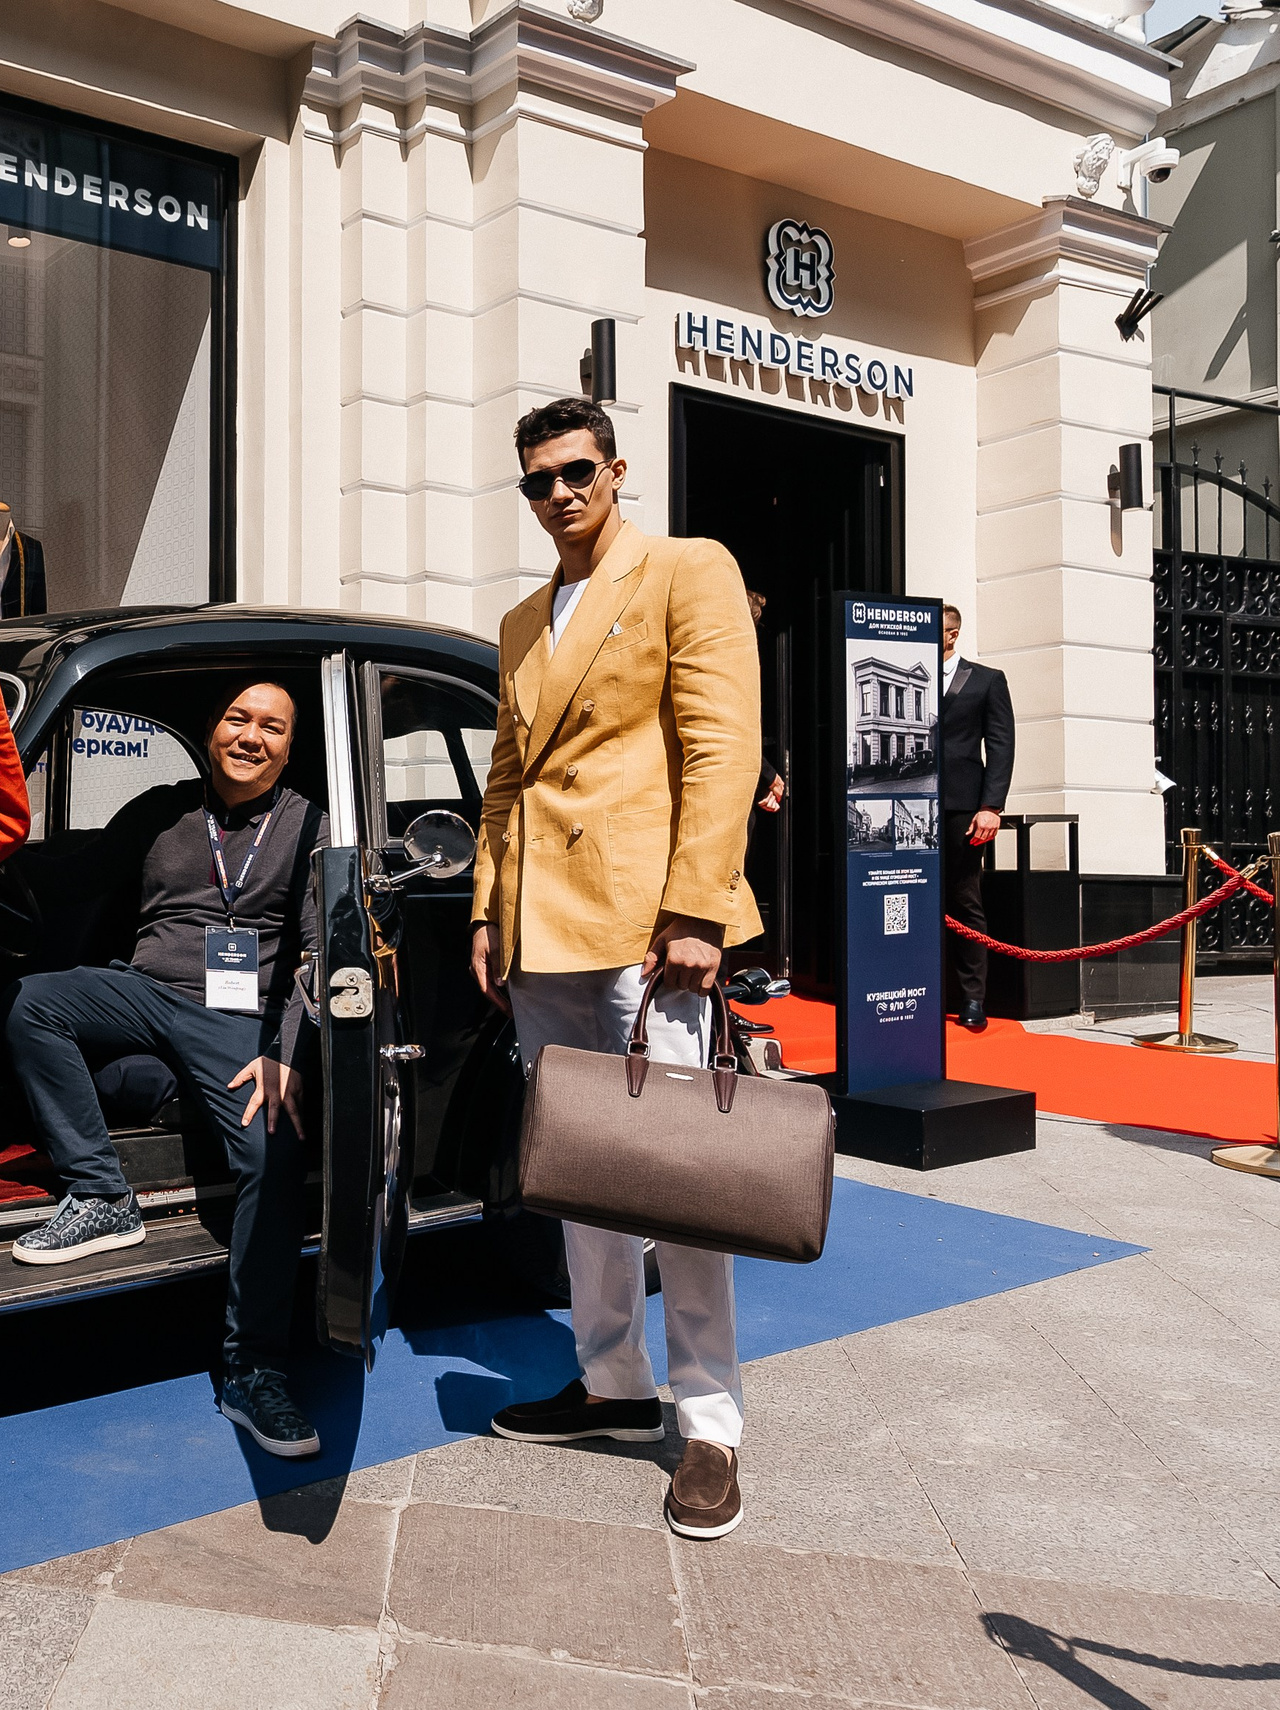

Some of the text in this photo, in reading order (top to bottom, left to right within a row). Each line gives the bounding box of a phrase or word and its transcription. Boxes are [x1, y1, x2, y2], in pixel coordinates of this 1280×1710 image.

[680, 311, 915, 400] HENDERSON
[867, 608, 932, 624] HENDERSON
[72, 737, 148, 758] еркам!
[866, 987, 927, 1002] КУЗНЕЦКИЙ МОСТ
[889, 1001, 904, 1012] 9/10
